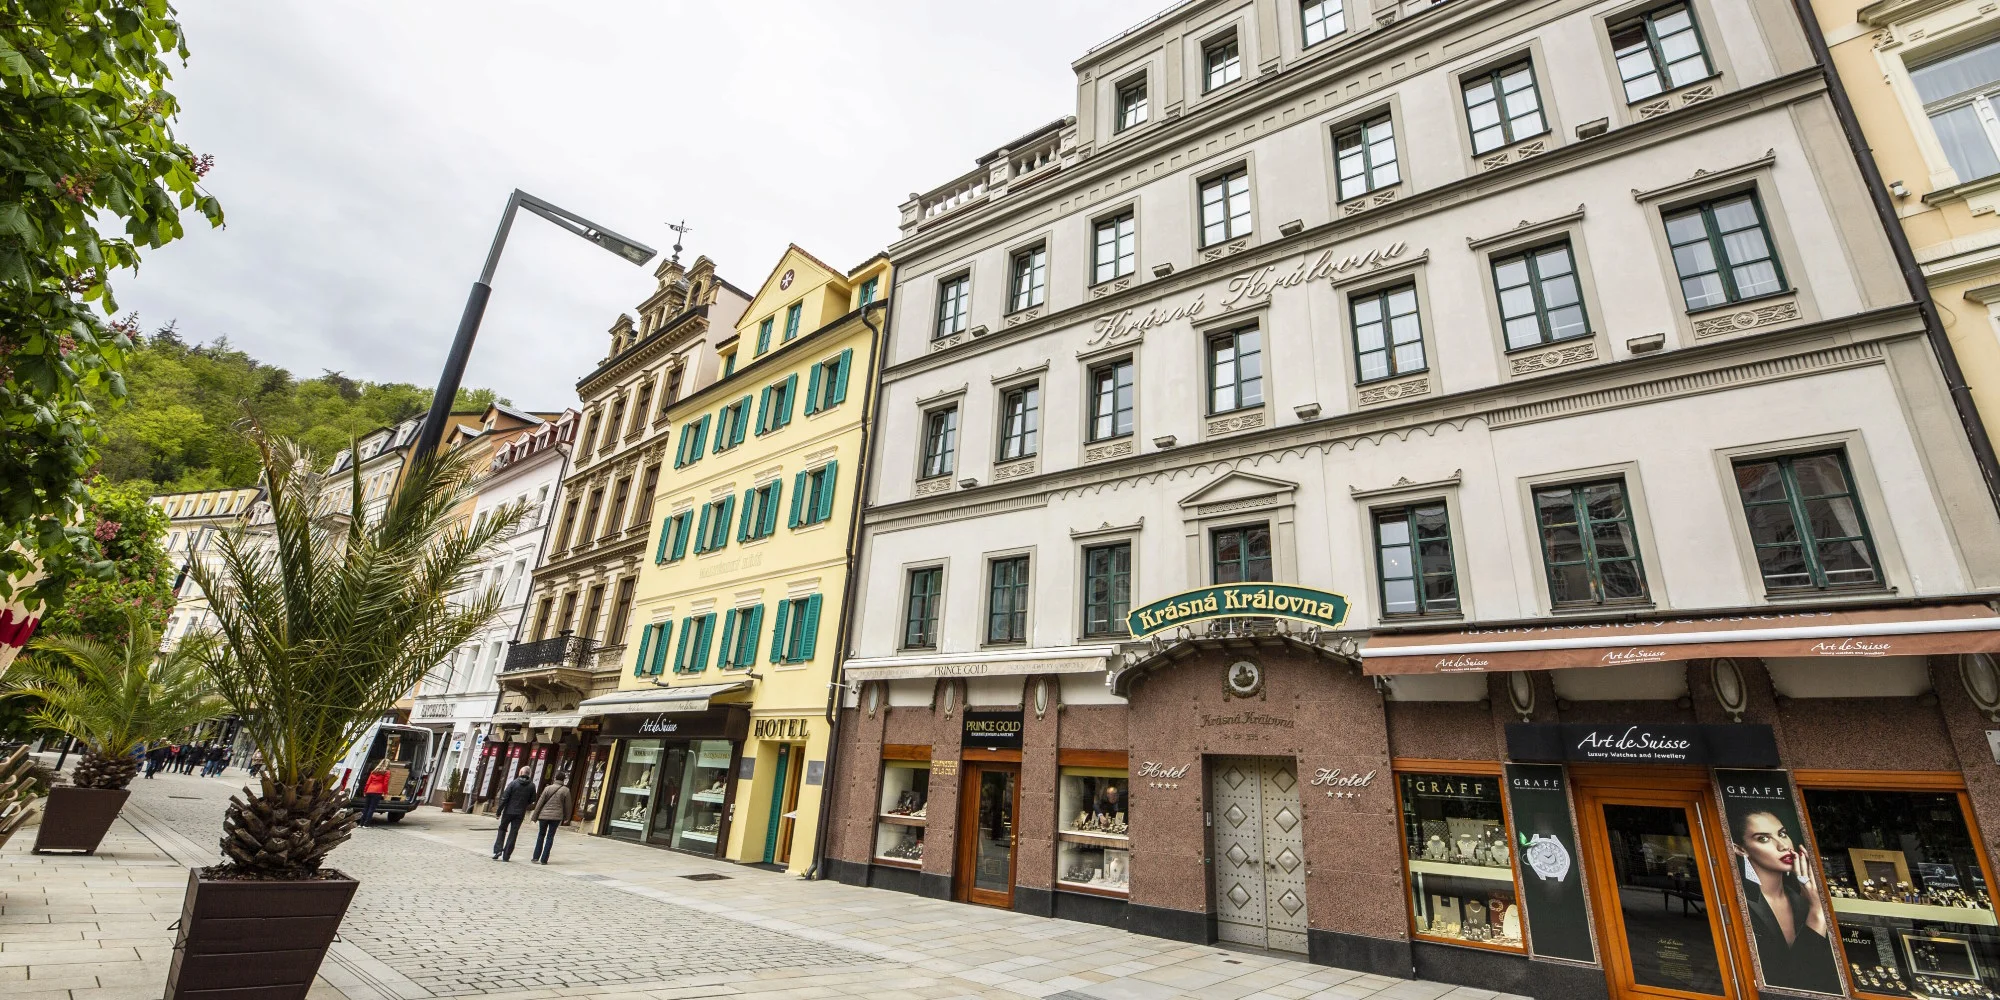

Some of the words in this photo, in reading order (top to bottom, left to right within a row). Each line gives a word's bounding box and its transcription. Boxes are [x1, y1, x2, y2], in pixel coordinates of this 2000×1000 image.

[1087, 292, 1206, 346] Krásná
[1221, 238, 1408, 306] Královna
[1138, 592, 1218, 630] Krásná
[1224, 589, 1334, 620] Královna
[1811, 643, 1837, 652] Art
[1839, 638, 1854, 651] de
[1853, 641, 1892, 651] Suisse
[1435, 658, 1453, 668] Art
[1454, 655, 1465, 667] de
[1463, 658, 1489, 666] Suisse
[1602, 652, 1622, 662] Art
[1624, 648, 1637, 659] de
[1636, 650, 1666, 658] Suisse
[934, 665, 962, 676] PRINCE
[964, 664, 988, 674] GOLD
[639, 718, 654, 733] Art
[652, 713, 663, 732] de
[660, 718, 678, 732] Suisse
[754, 718, 810, 738] HOTEL
[966, 720, 994, 731] PRINCE
[996, 720, 1020, 732] GOLD
[1200, 714, 1240, 728] Krásná
[1578, 732, 1614, 749] Art
[1615, 726, 1638, 750] de
[1636, 733, 1690, 749] Suisse
[1138, 761, 1191, 780] Hotel
[1311, 768, 1377, 787] Hotel
[1416, 781, 1483, 795] GRAFF
[1514, 778, 1559, 787] GRAFF
[1726, 786, 1783, 795] GRAFF
[1842, 937, 1871, 945] HUBLOT
